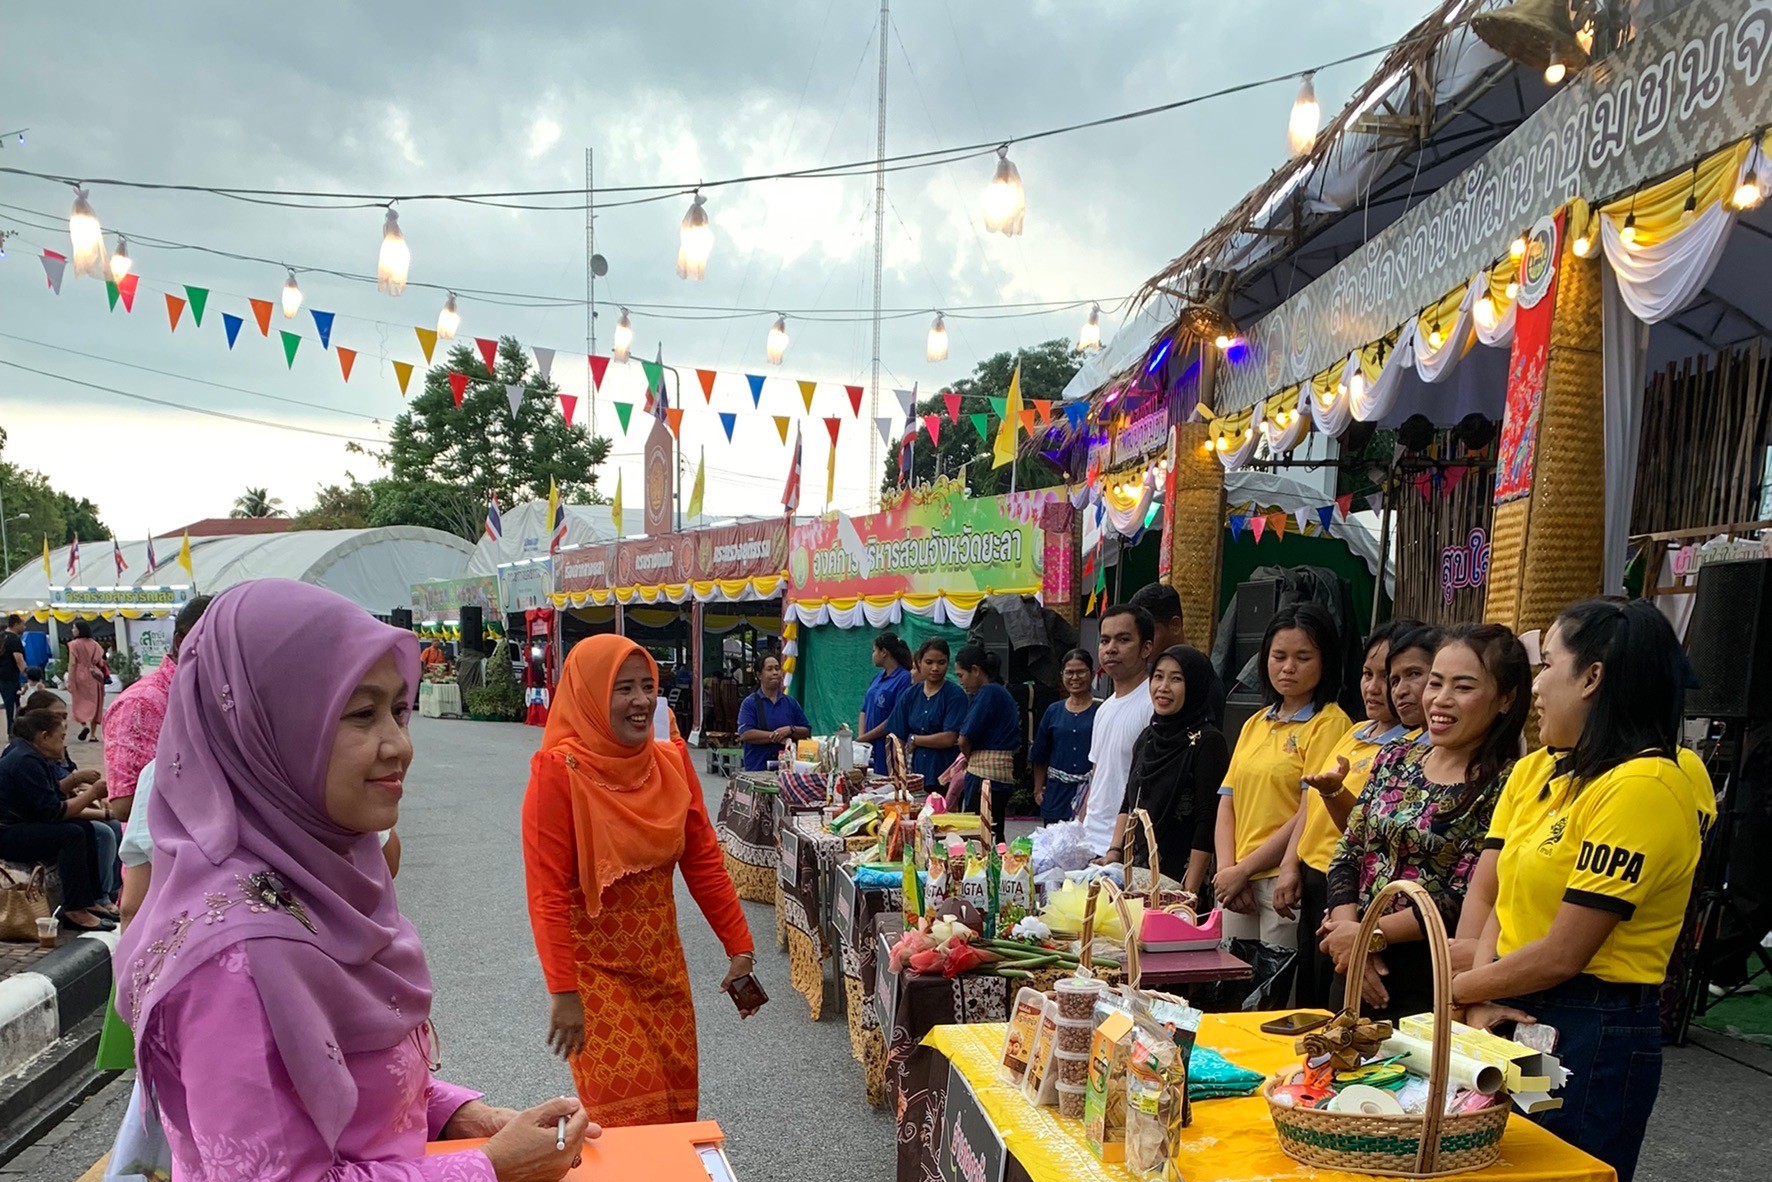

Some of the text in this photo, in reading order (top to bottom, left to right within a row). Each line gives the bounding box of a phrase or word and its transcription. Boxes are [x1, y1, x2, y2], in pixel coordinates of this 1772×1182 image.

[813, 524, 1022, 578] องค์การริหารส่วนจังหวัดยะลา
[1576, 840, 1646, 884] DOPA
